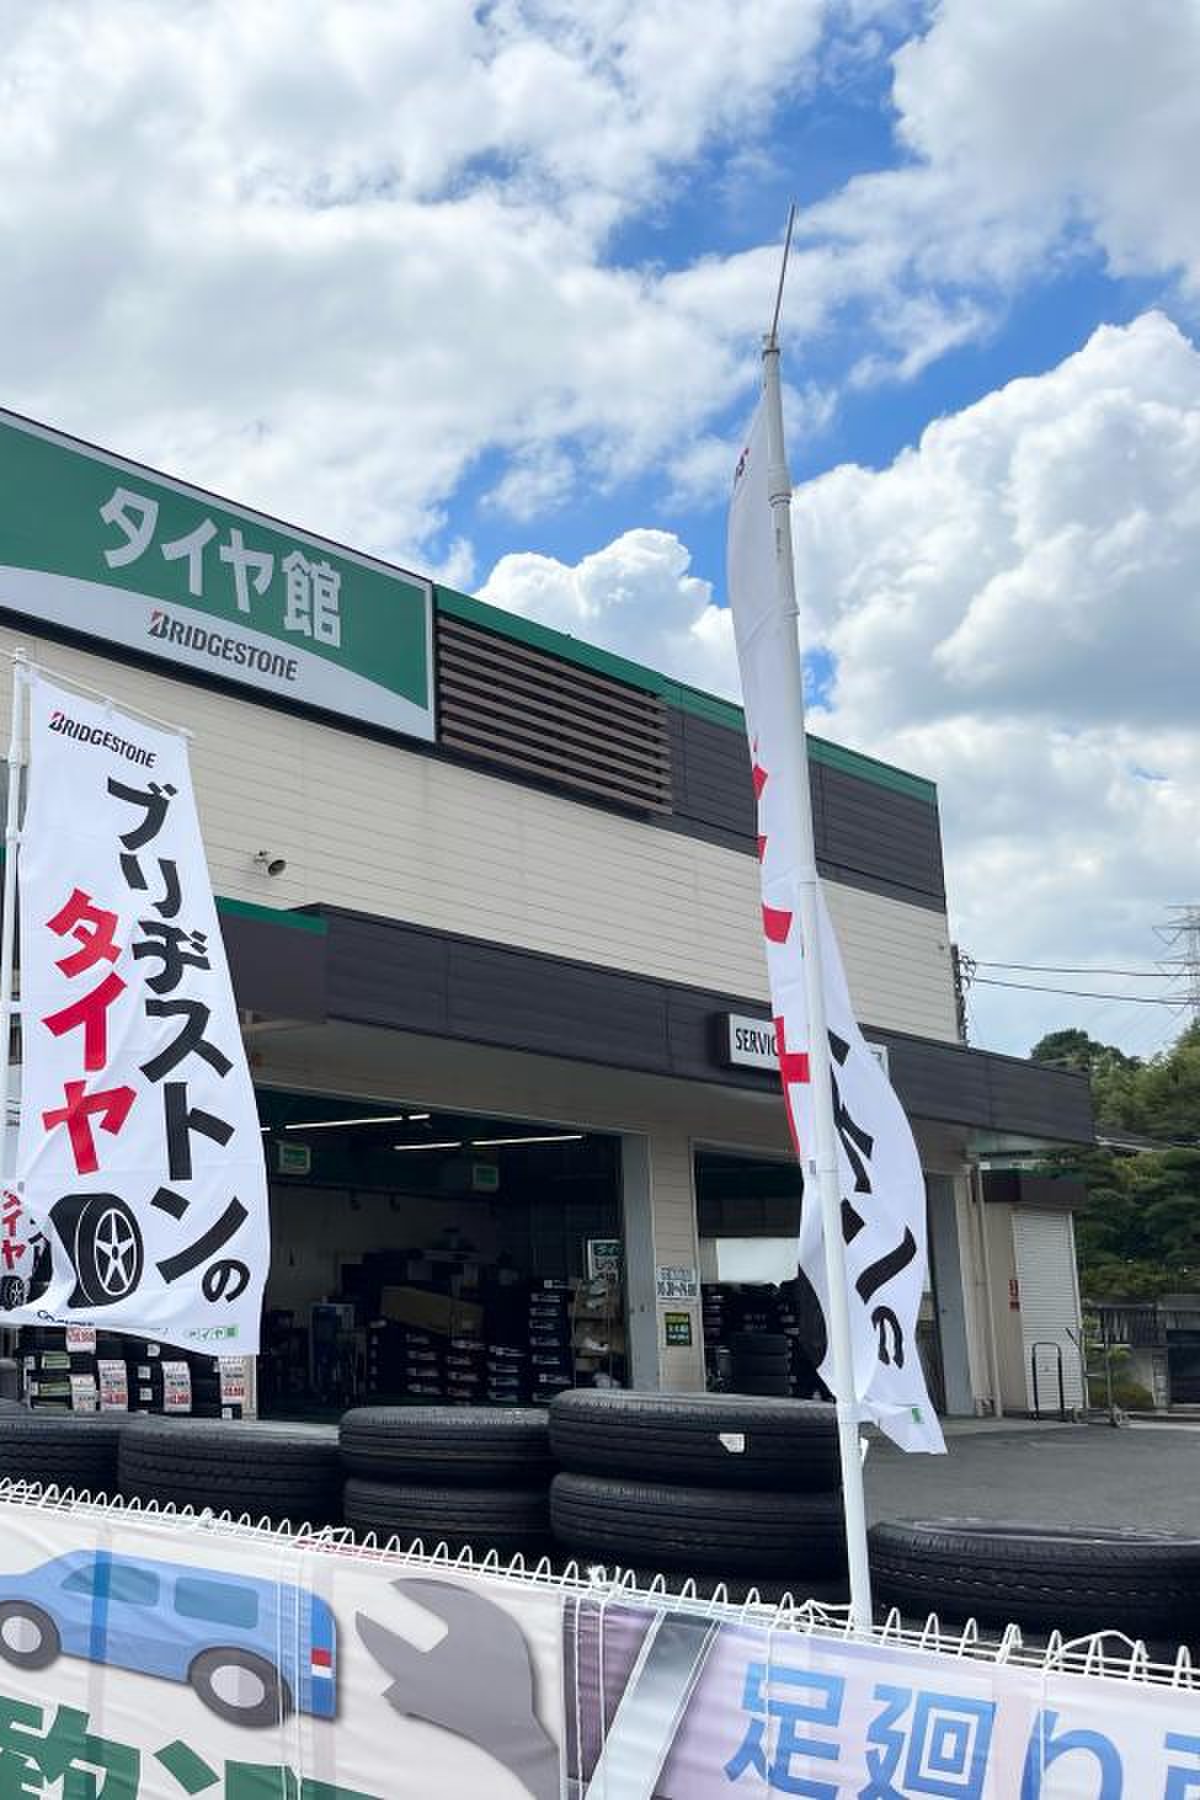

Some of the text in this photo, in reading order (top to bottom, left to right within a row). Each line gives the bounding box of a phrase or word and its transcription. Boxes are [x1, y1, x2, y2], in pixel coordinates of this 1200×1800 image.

[100, 486, 341, 647] タイヤ館
[147, 610, 298, 681] BRIDGESTONE
[48, 710, 159, 769] BRIDGESTONE
[41, 887, 138, 1175] タイヤ
[106, 775, 250, 1304] ブリヂストンの
